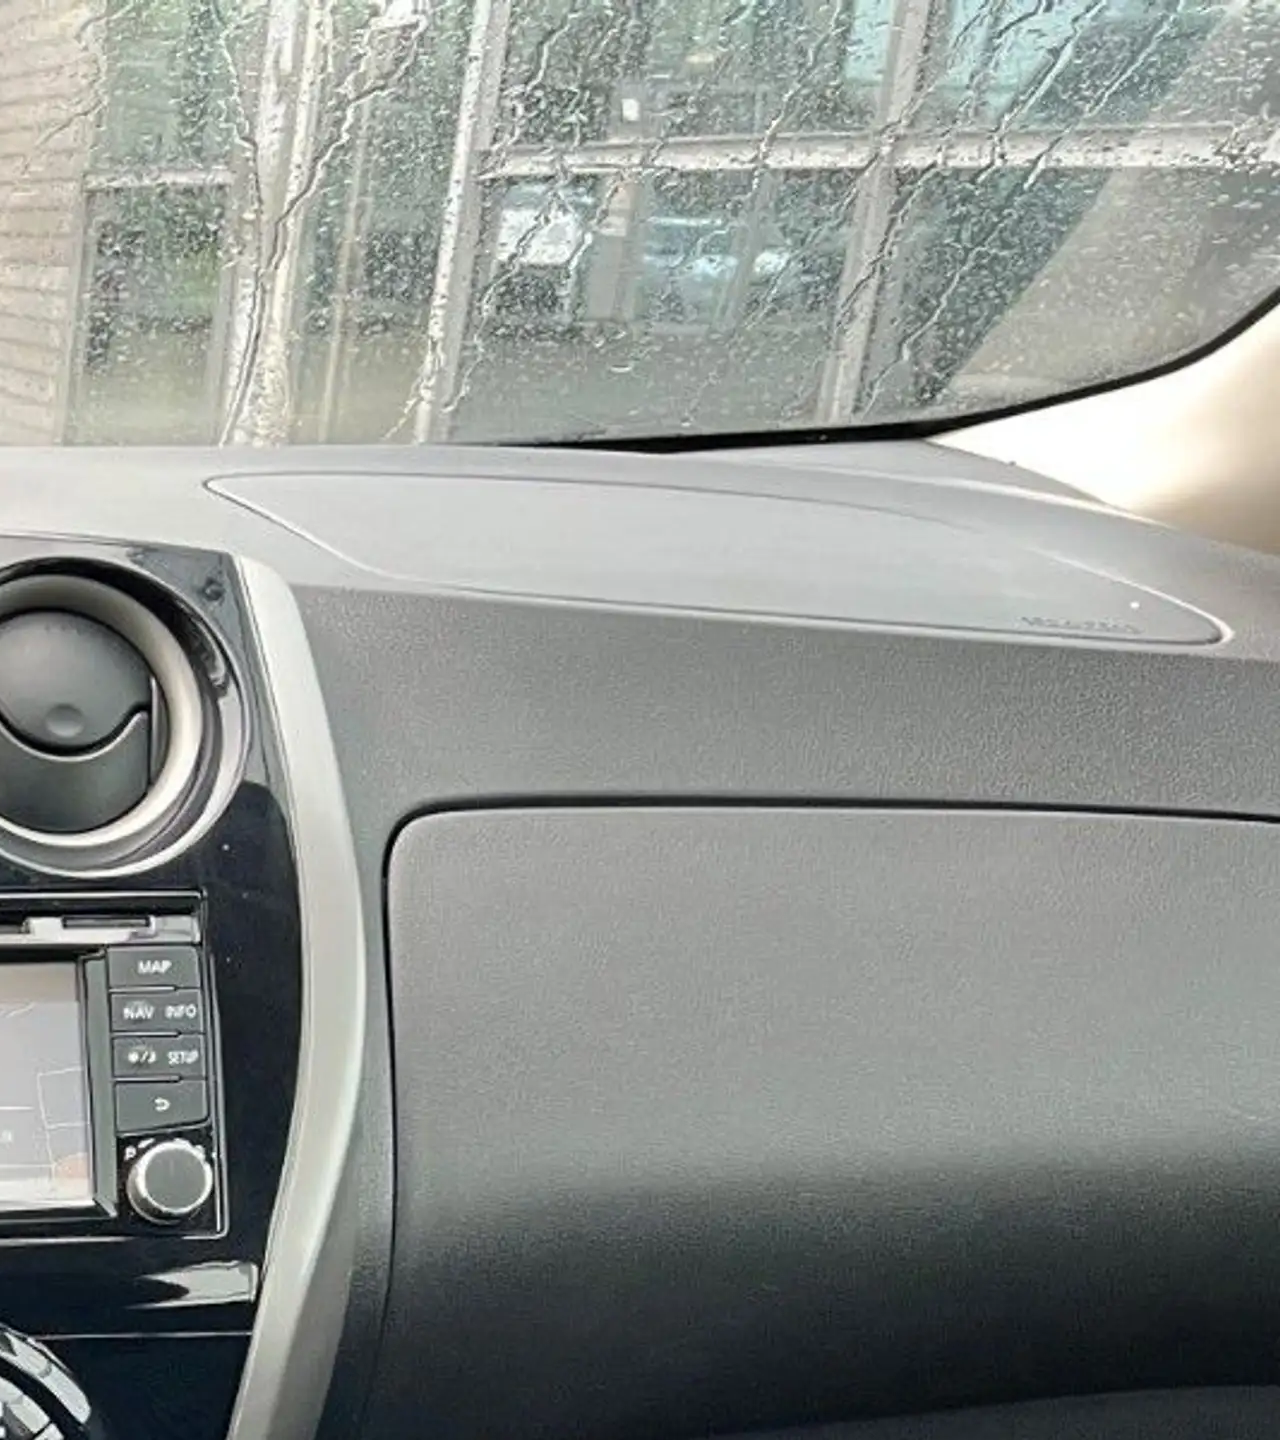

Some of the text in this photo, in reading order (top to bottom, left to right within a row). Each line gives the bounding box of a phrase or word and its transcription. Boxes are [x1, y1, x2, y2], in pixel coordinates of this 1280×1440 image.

[137, 959, 172, 974] MAP
[123, 1004, 198, 1020] NAV INFO
